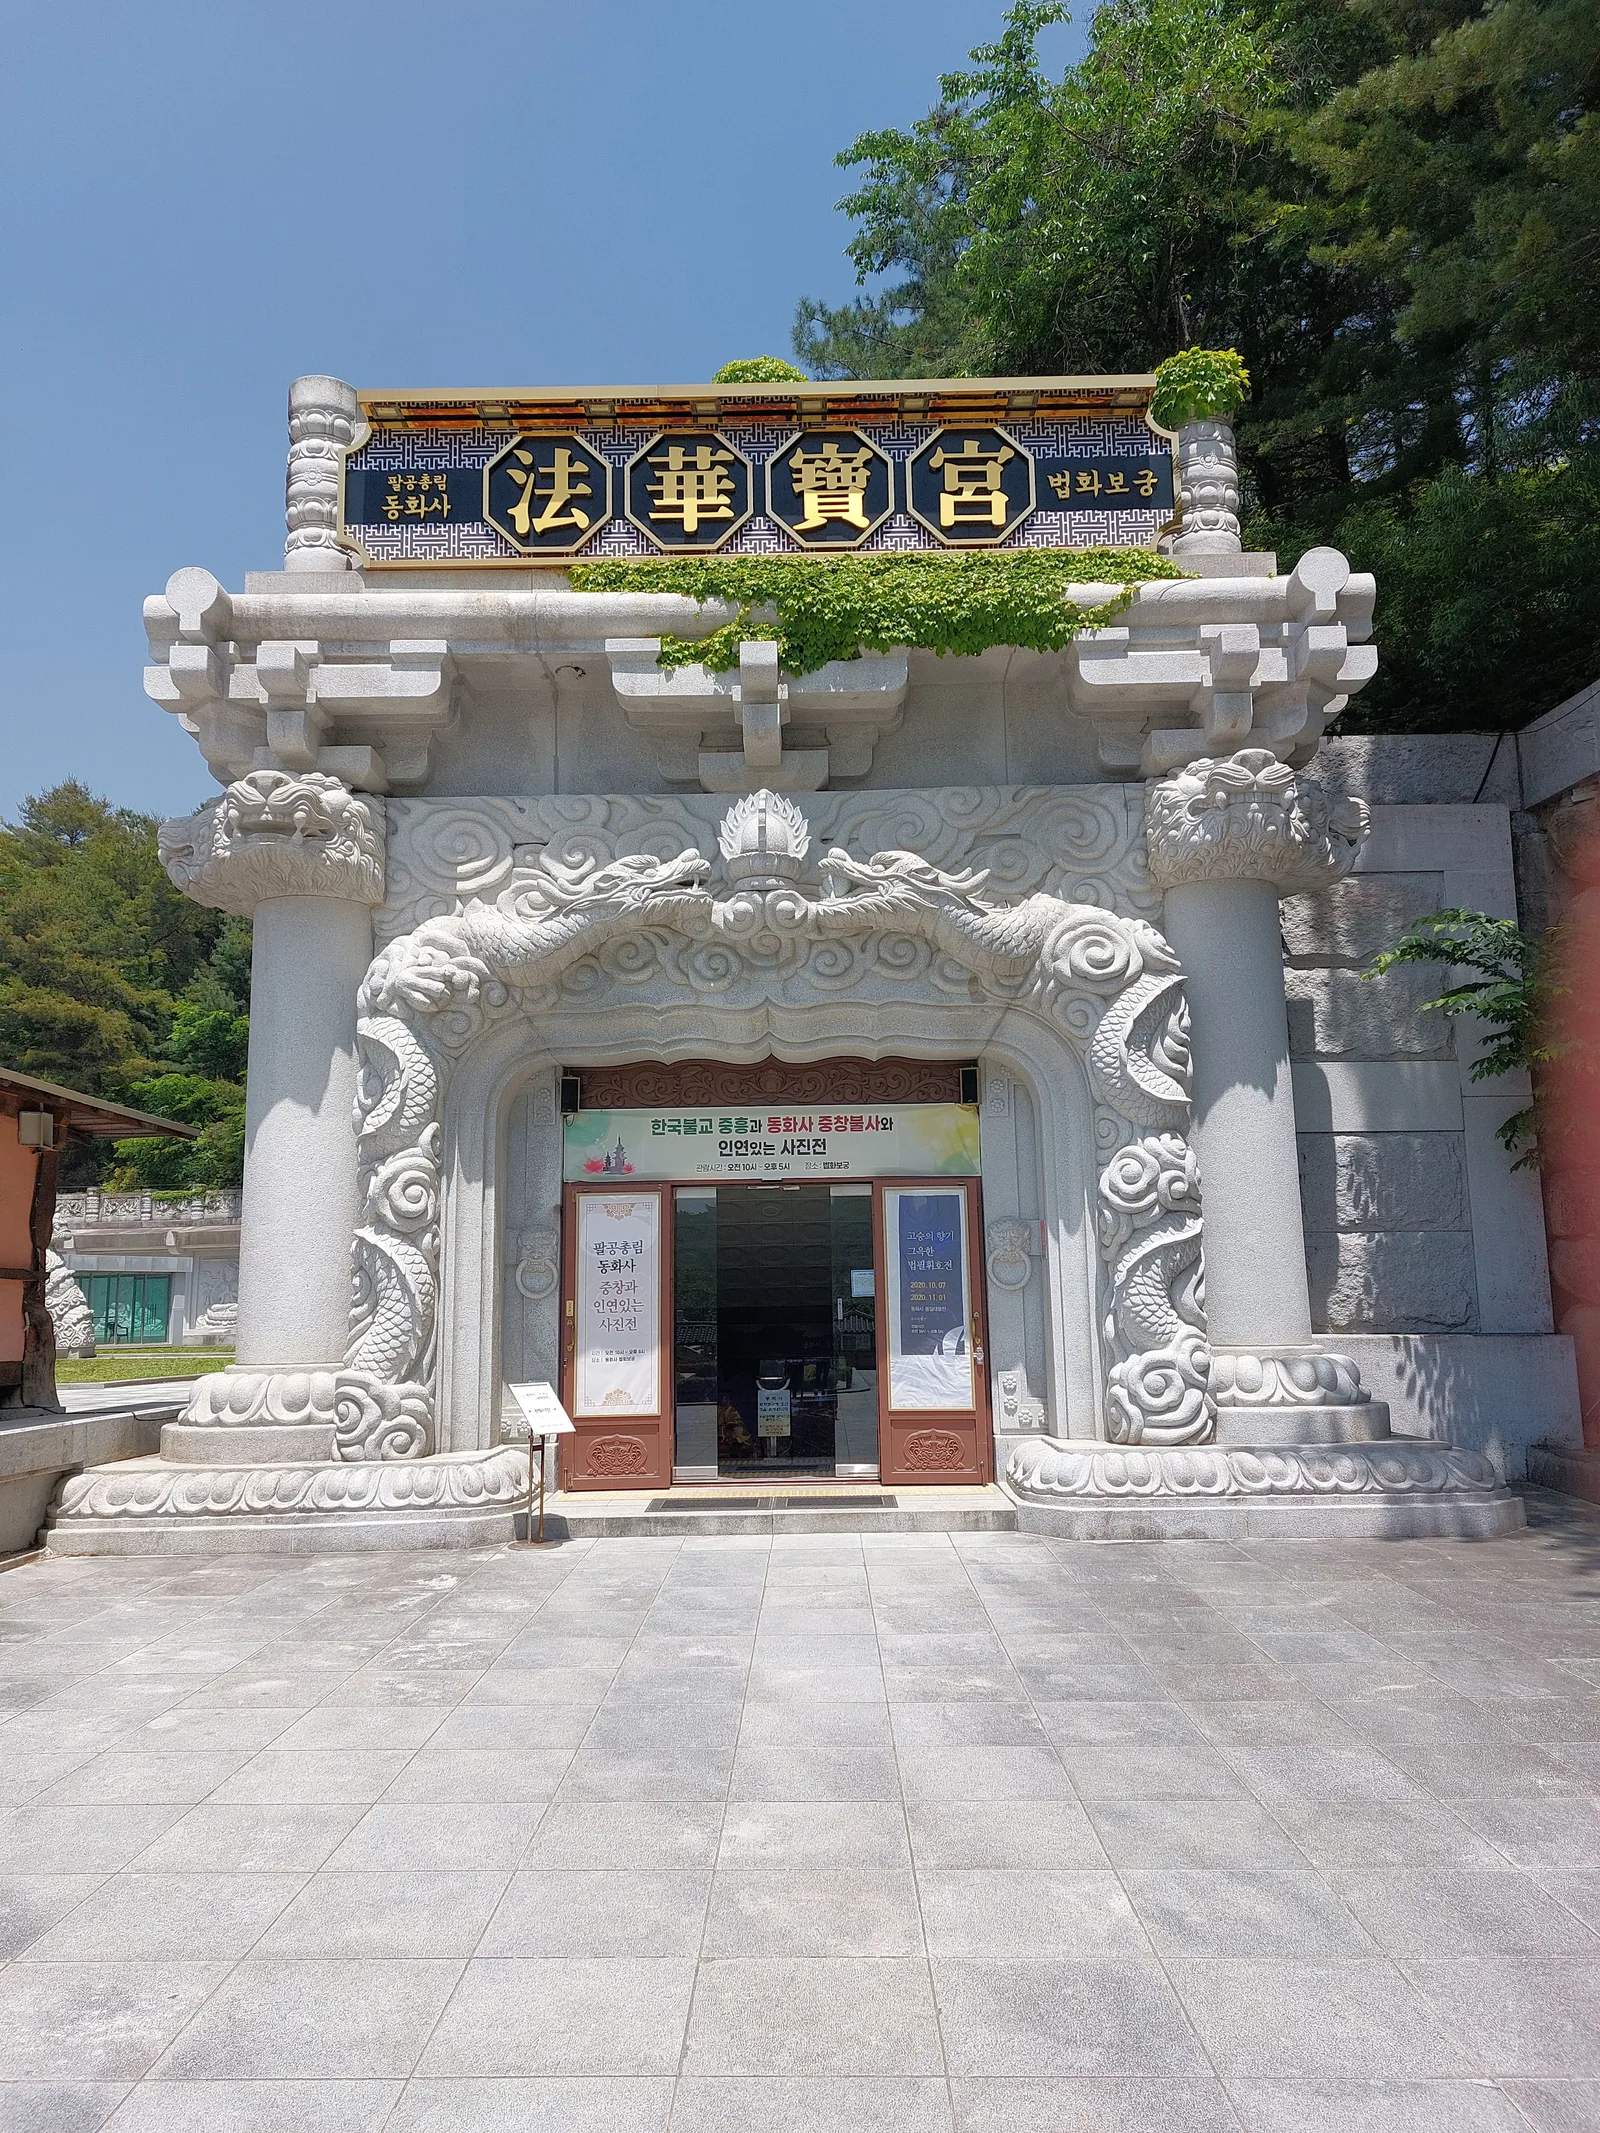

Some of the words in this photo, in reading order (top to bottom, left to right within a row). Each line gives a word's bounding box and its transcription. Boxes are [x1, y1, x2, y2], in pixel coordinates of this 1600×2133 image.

[387, 473, 447, 492] 팔공총림
[506, 440, 1015, 536] 法華寶宮
[1046, 469, 1159, 501] 법화보궁
[381, 494, 452, 521] 동화사
[651, 1118, 713, 1136] 한국불교
[718, 1117, 763, 1135] 중흥과
[767, 1116, 814, 1134] 동화사
[818, 1115, 894, 1133] 중창불사와
[718, 1139, 775, 1157] 인연있는
[780, 1138, 827, 1156] 사진전
[727, 1163, 741, 1172] 오전
[742, 1162, 757, 1171] 10시
[763, 1162, 777, 1171] 오후
[778, 1162, 790, 1170] 5시
[907, 1231, 934, 1241] 고승의
[936, 1231, 954, 1241] 향기
[593, 1240, 643, 1255] 팔공총림
[597, 1259, 637, 1275] 동화사
[599, 1280, 638, 1296] 중창과
[593, 1299, 644, 1314] 인연있는
[599, 1317, 638, 1333] 사진전
